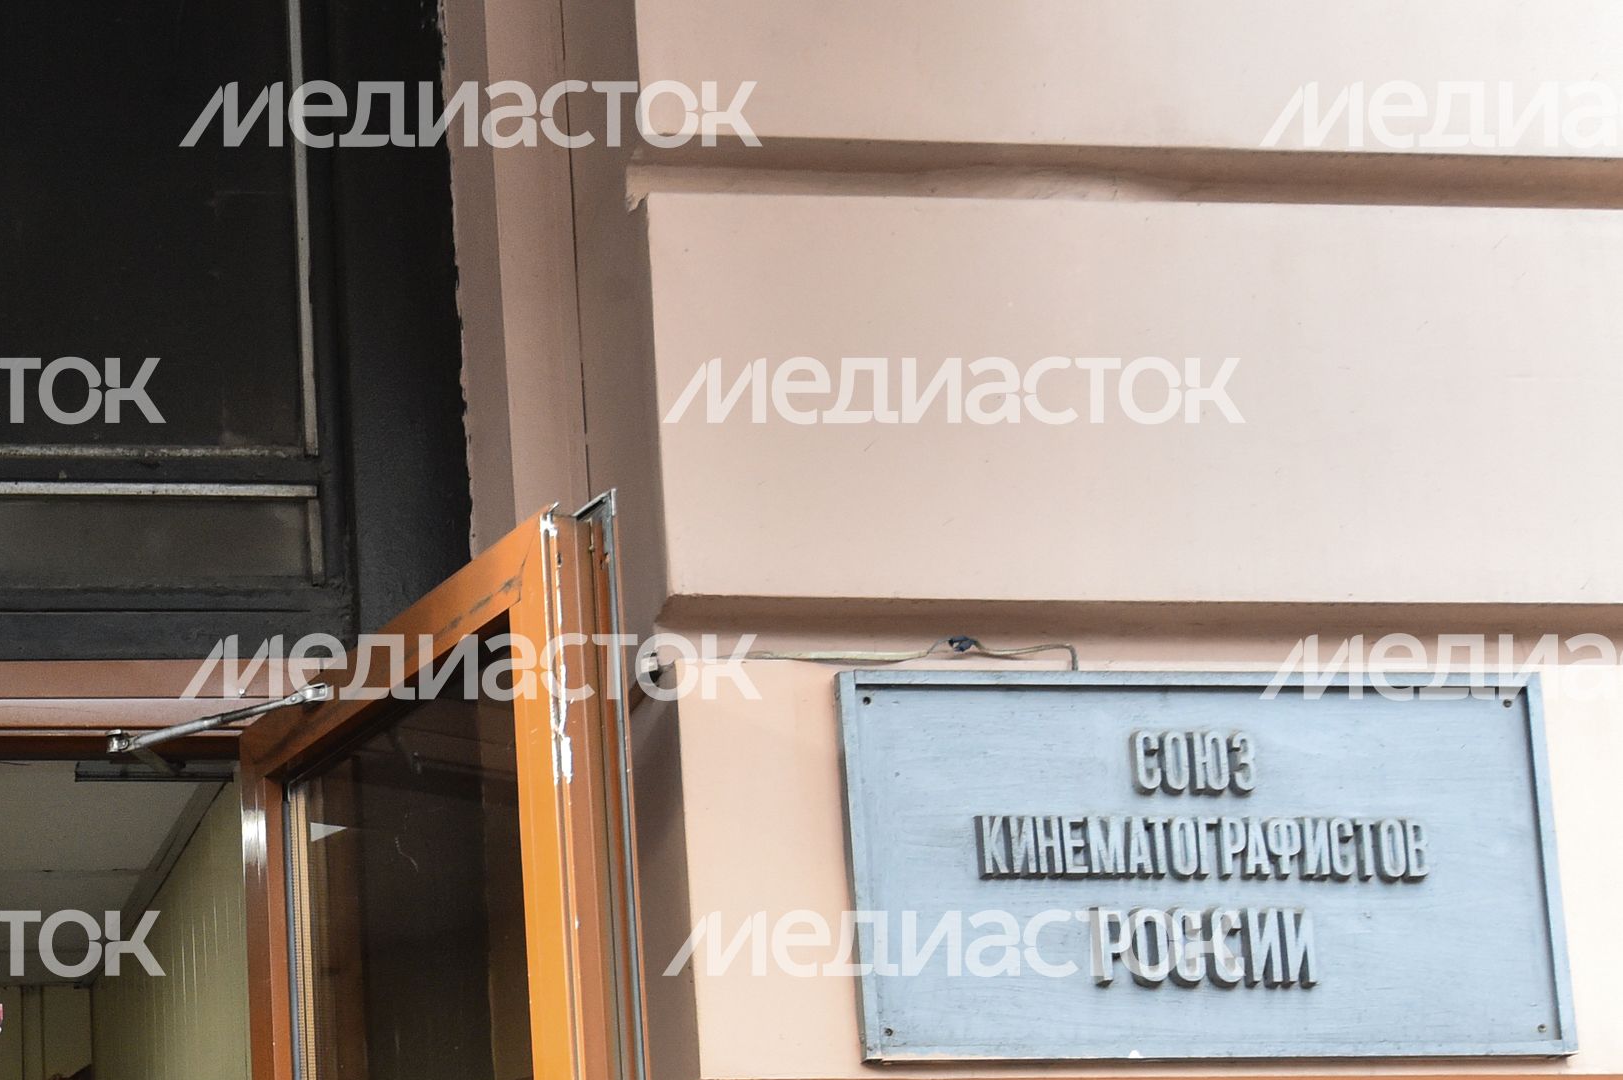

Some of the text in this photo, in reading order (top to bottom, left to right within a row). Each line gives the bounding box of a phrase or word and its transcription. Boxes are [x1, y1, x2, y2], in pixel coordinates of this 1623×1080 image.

[1128, 727, 1257, 795] СОЮЗ
[975, 814, 1430, 882] КИНЕМАТОГРАФИСТОВ
[1089, 905, 1319, 989] РОССИИ
